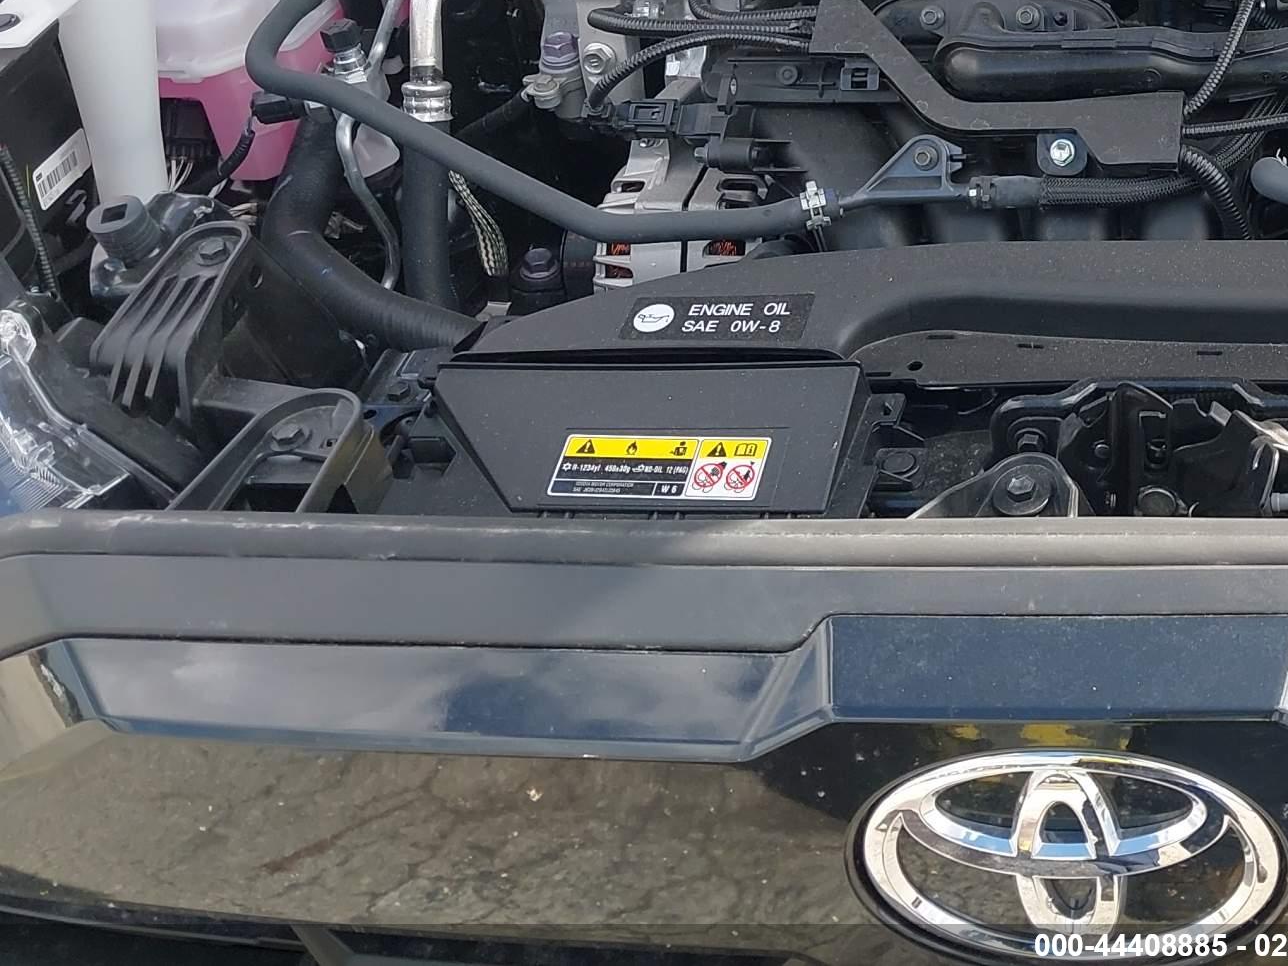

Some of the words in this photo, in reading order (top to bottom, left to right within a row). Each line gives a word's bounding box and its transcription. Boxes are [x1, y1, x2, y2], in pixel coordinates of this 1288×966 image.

[688, 303, 753, 316] ENGINE
[763, 302, 790, 316] OIL
[681, 320, 719, 332] SAE
[730, 320, 781, 333] 0W-8
[661, 485, 671, 493] W
